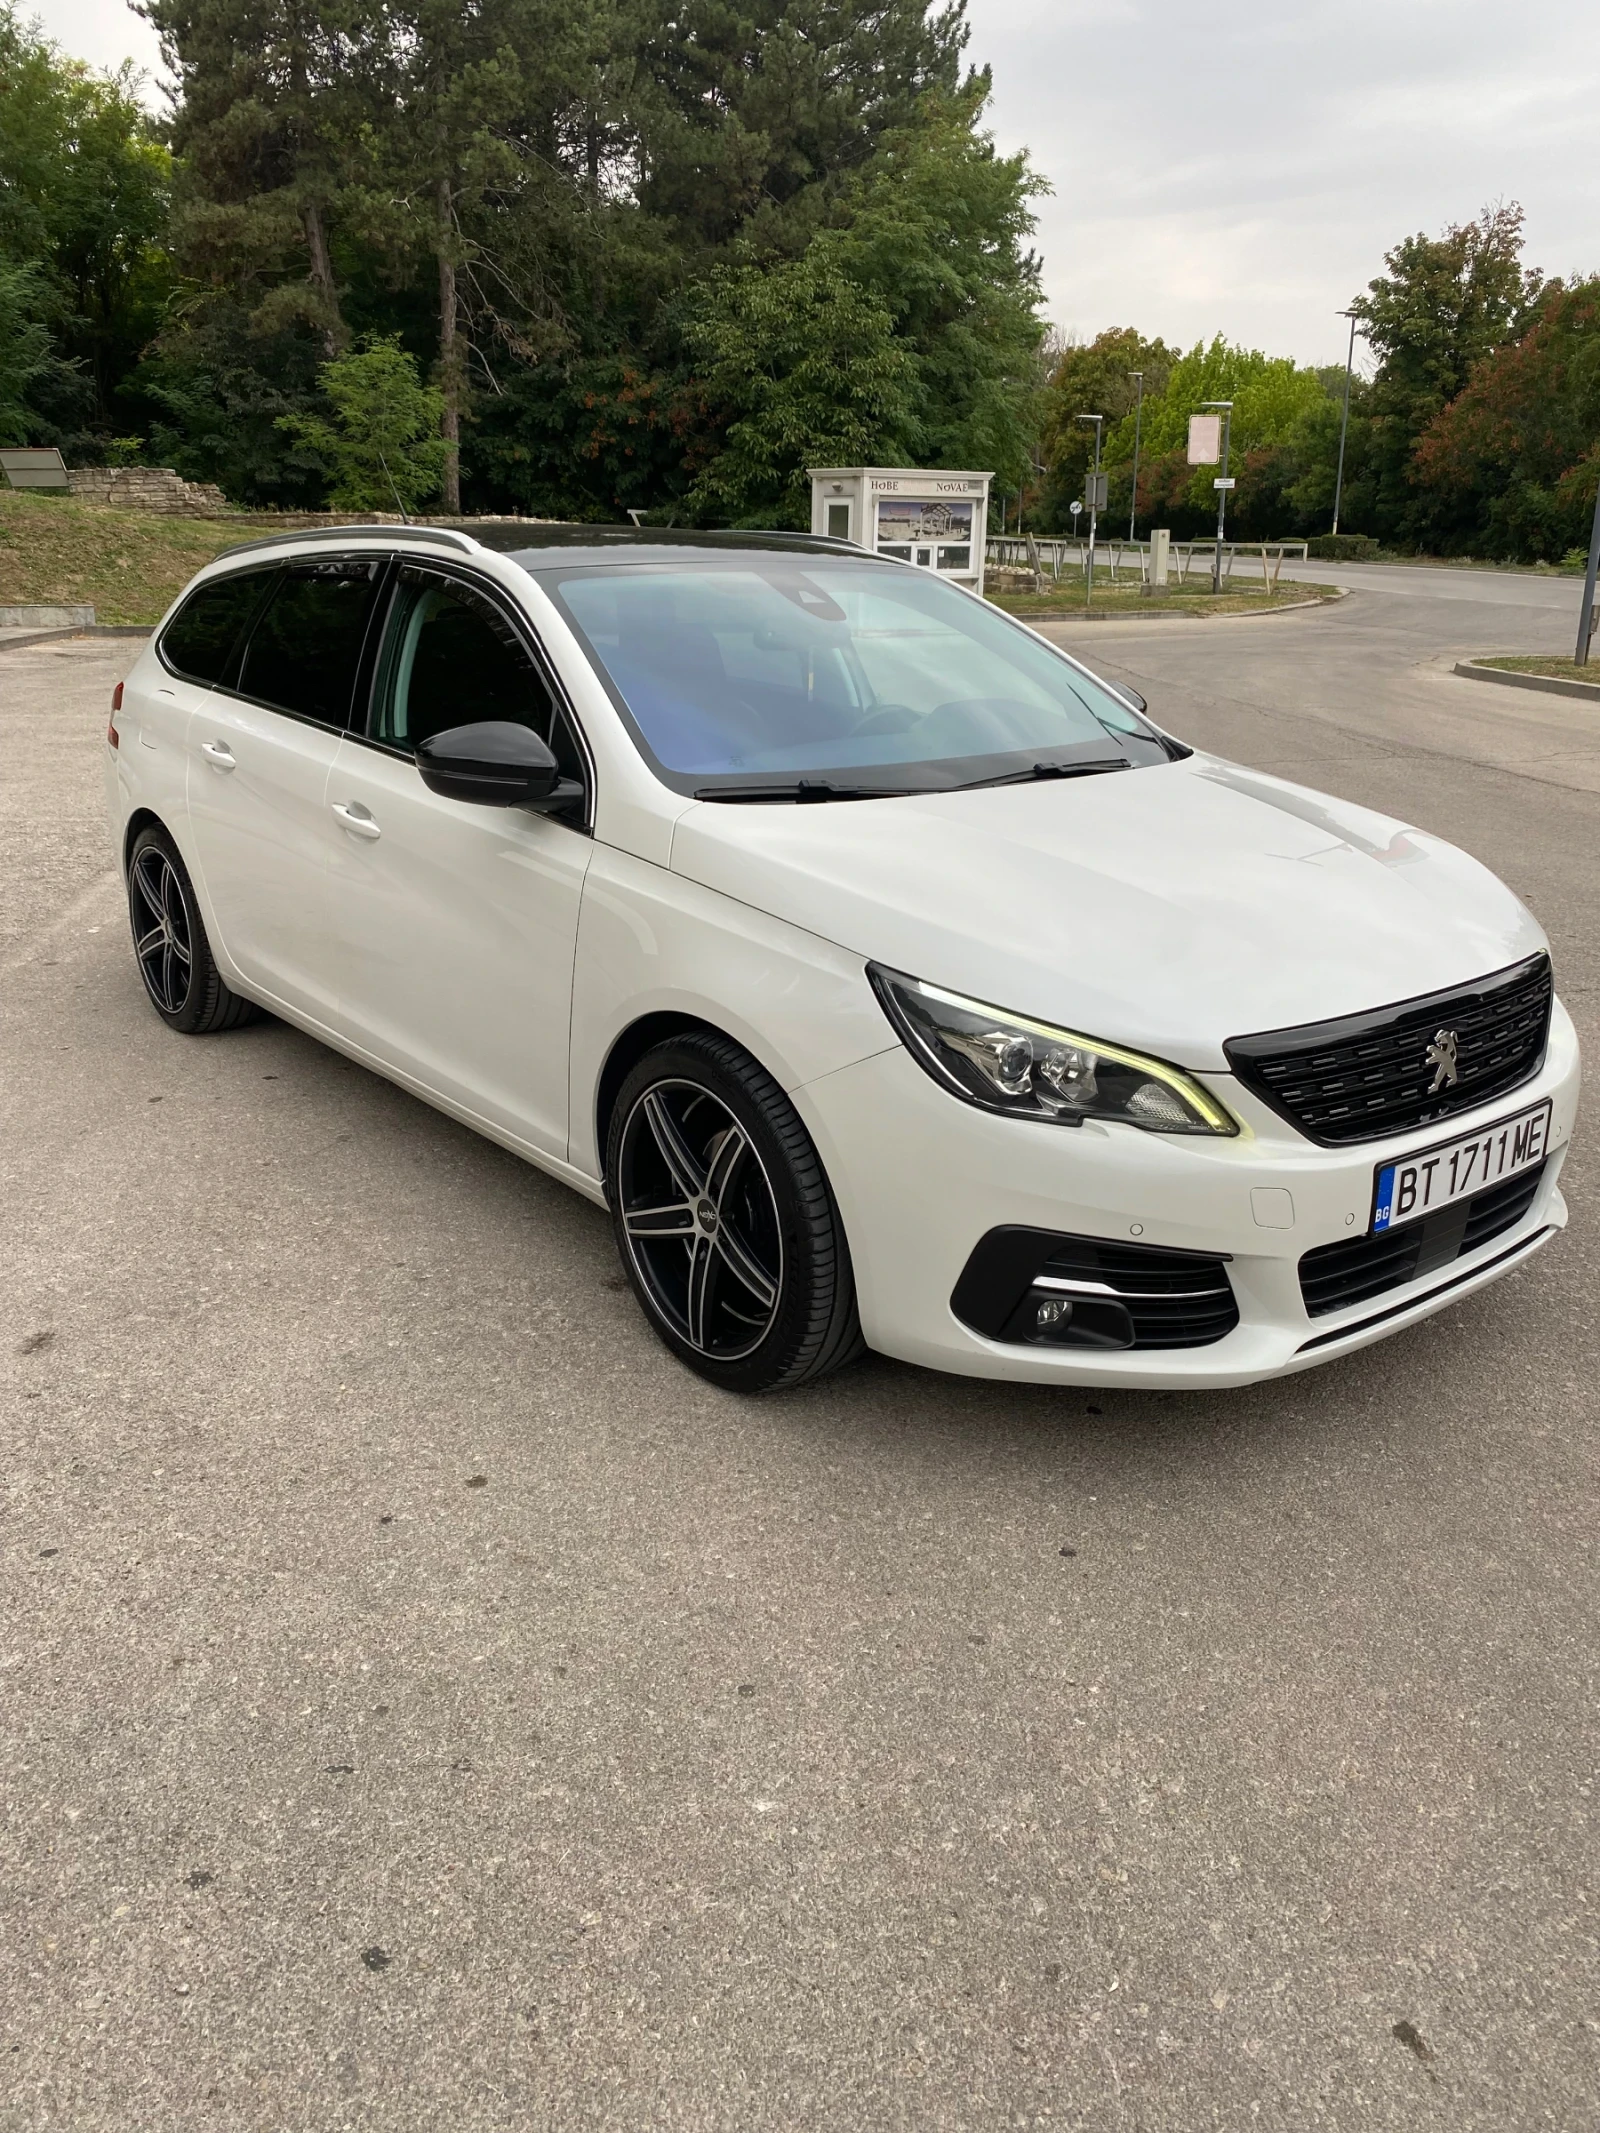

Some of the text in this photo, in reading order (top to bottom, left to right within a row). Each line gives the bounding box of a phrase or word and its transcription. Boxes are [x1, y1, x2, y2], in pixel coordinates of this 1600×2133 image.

[1396, 1113, 1545, 1216] BT 1711 ME
[1375, 1205, 1390, 1223] BG
